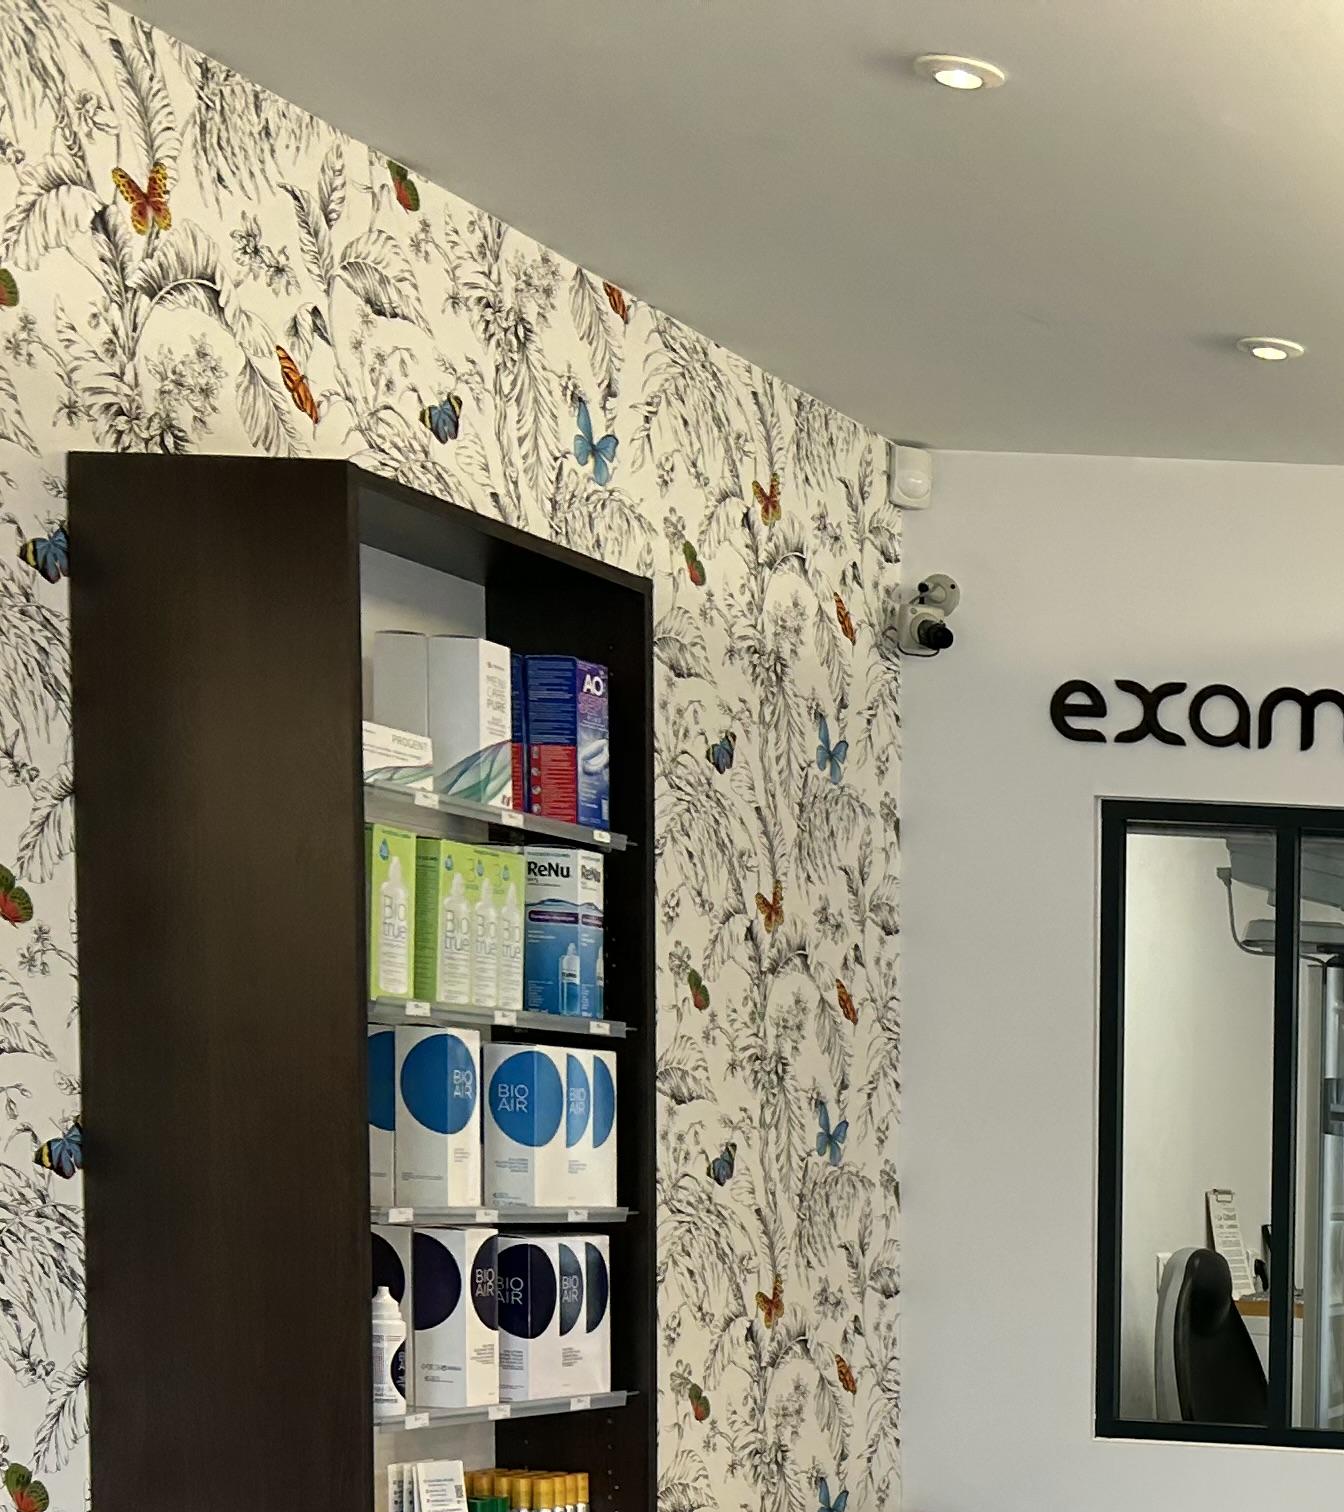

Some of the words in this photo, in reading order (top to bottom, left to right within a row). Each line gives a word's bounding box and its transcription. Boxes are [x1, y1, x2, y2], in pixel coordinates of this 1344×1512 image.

[527, 861, 570, 878] ReNu
[452, 1069, 473, 1083] BIO
[498, 1084, 529, 1099] BIO
[497, 1099, 528, 1113] AIR
[475, 1268, 494, 1284] BIO
[561, 1275, 579, 1289] BIO
[475, 1283, 495, 1297] AIR
[561, 1289, 579, 1302] AIR
